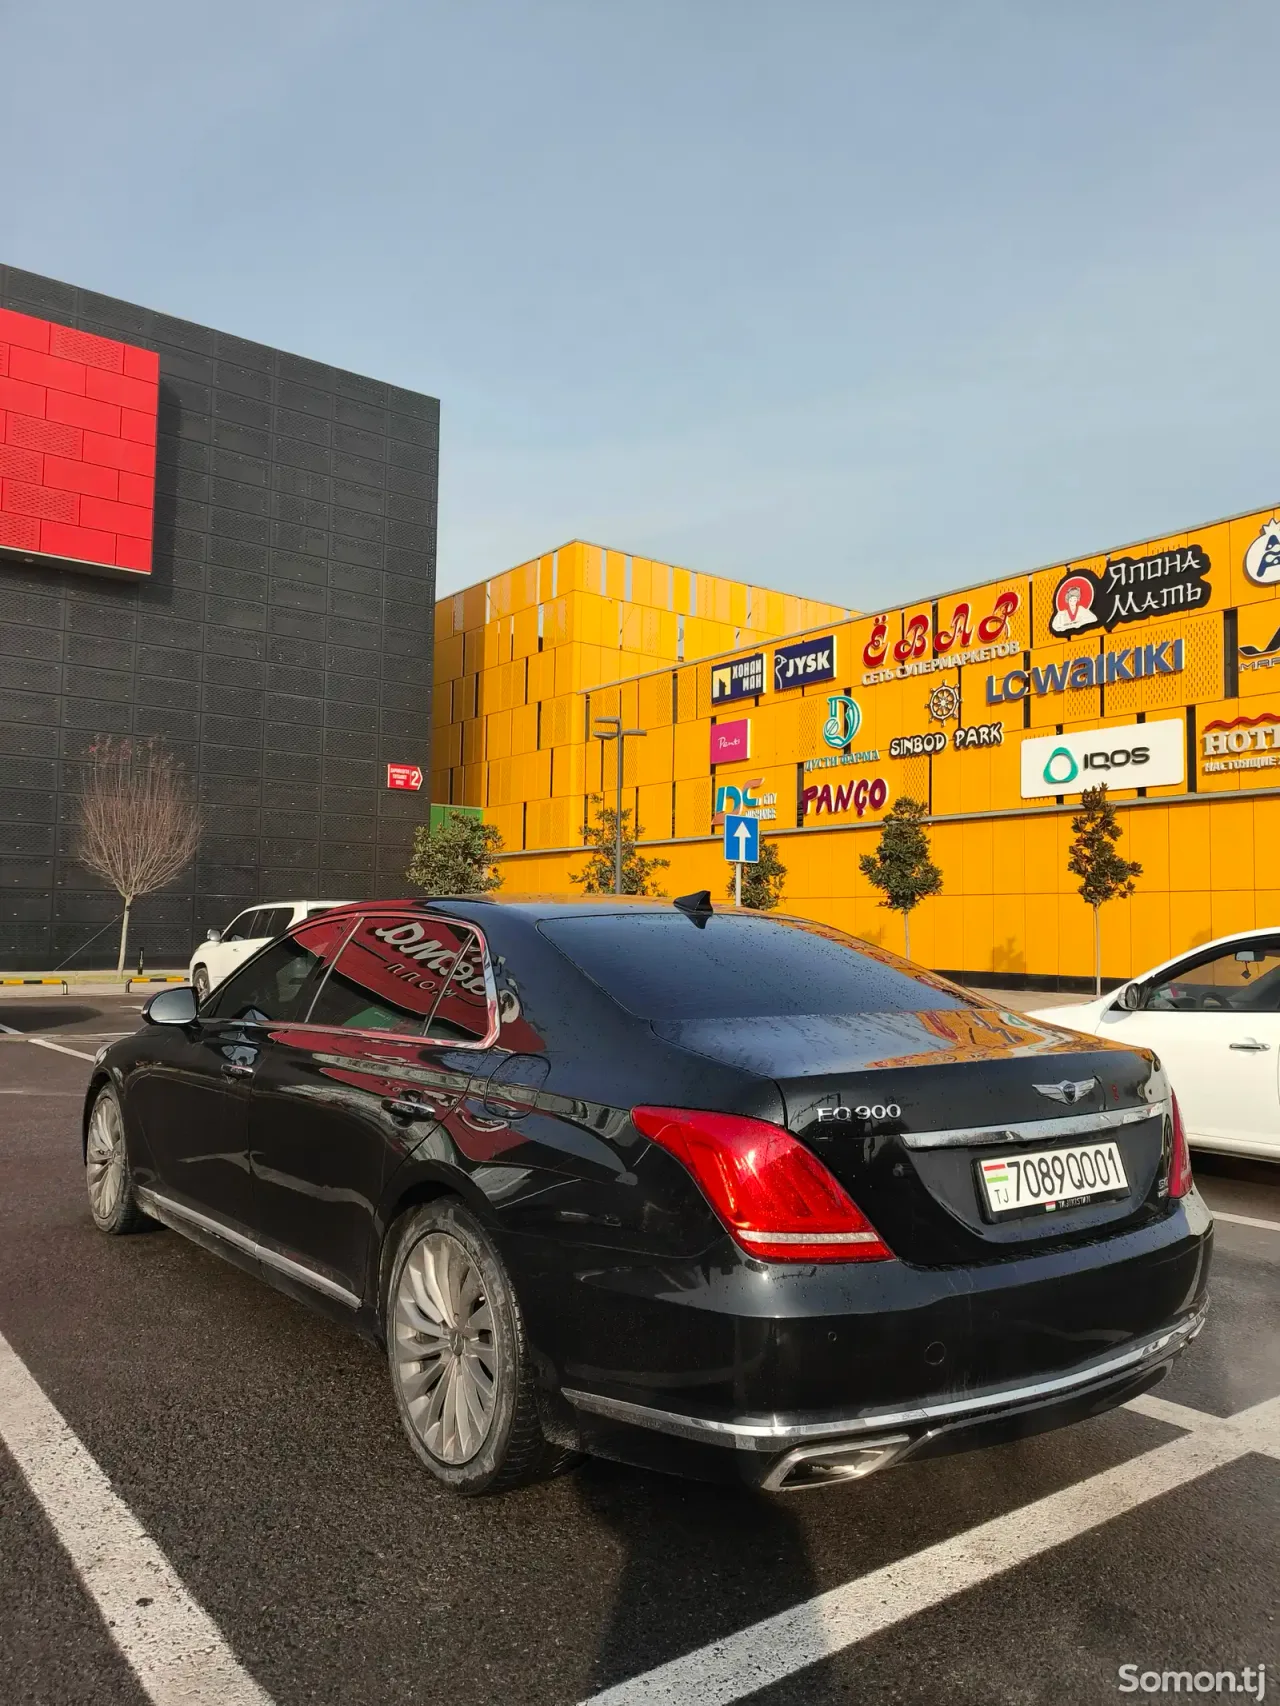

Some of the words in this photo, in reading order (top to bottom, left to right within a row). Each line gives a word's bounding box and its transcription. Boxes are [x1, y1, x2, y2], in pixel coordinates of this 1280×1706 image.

[863, 591, 1020, 667] ЁВАР
[785, 650, 831, 678] JYSK
[862, 668, 893, 686] СЕТЬ
[896, 641, 1020, 678] СУПЕРМАРКЕТОВ
[890, 733, 946, 756] SINBOD
[954, 724, 1002, 747] PARK
[840, 750, 880, 765] ФАРМА
[1083, 747, 1150, 771] IQOS
[1204, 756, 1277, 772] НАСТОЯЩИЕ
[411, 770, 419, 786] 2
[854, 1103, 902, 1120] 900
[994, 1188, 1010, 1204] TJ
